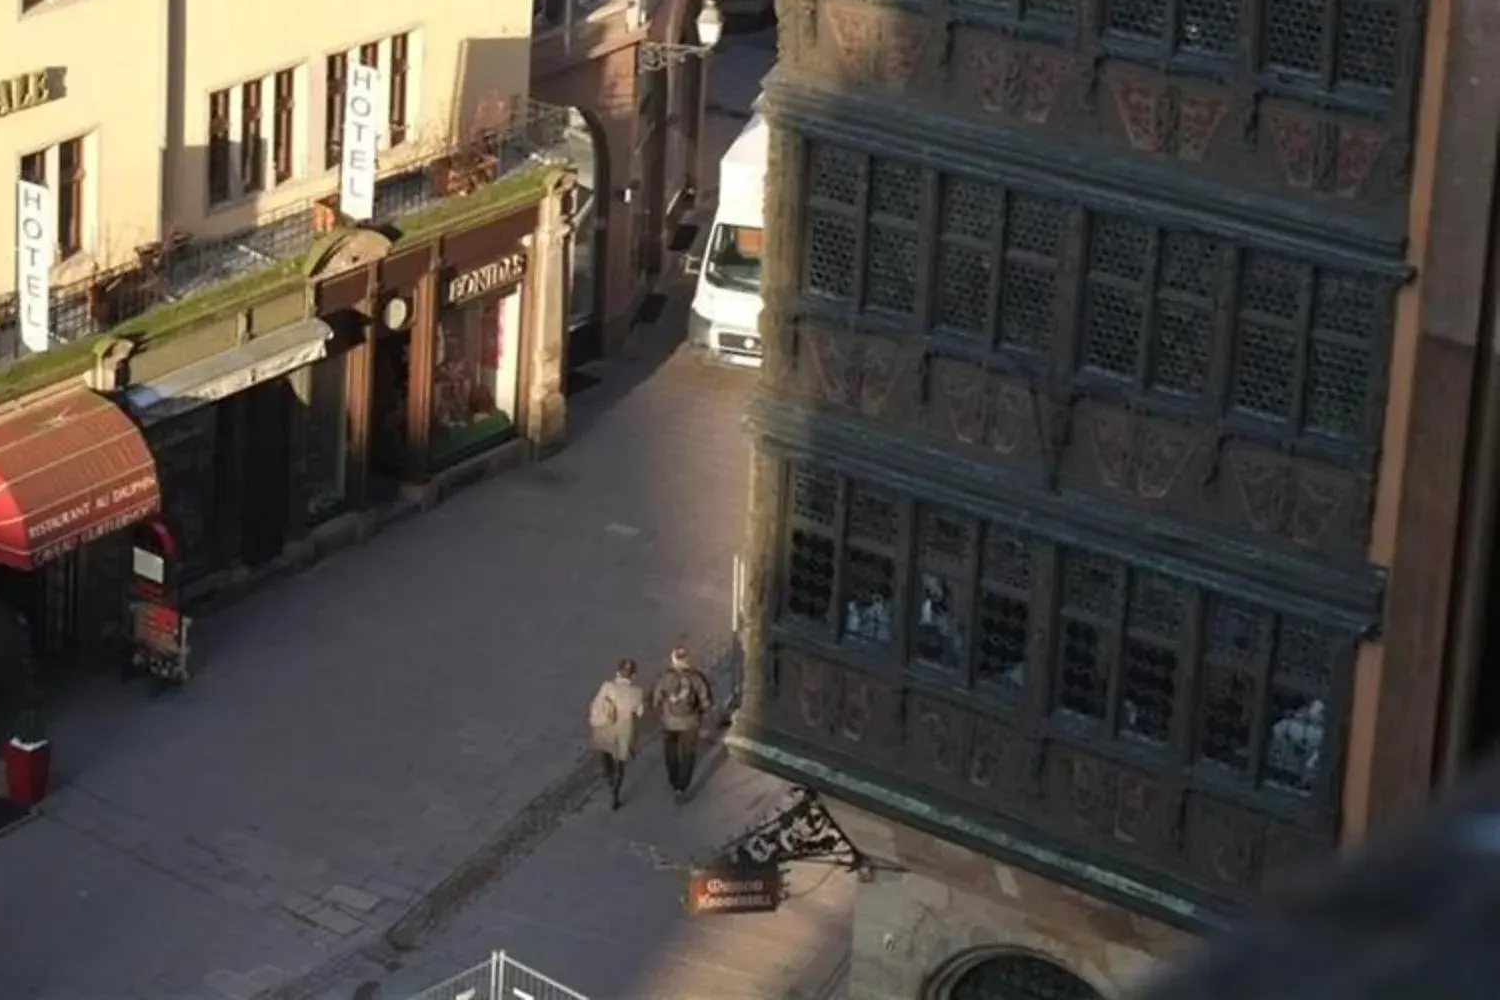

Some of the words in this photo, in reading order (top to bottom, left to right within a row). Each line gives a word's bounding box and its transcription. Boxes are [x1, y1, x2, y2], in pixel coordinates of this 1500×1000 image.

[350, 69, 371, 198] HOTEL
[22, 189, 44, 327] HOTEL
[29, 501, 92, 538] RESTAURANT
